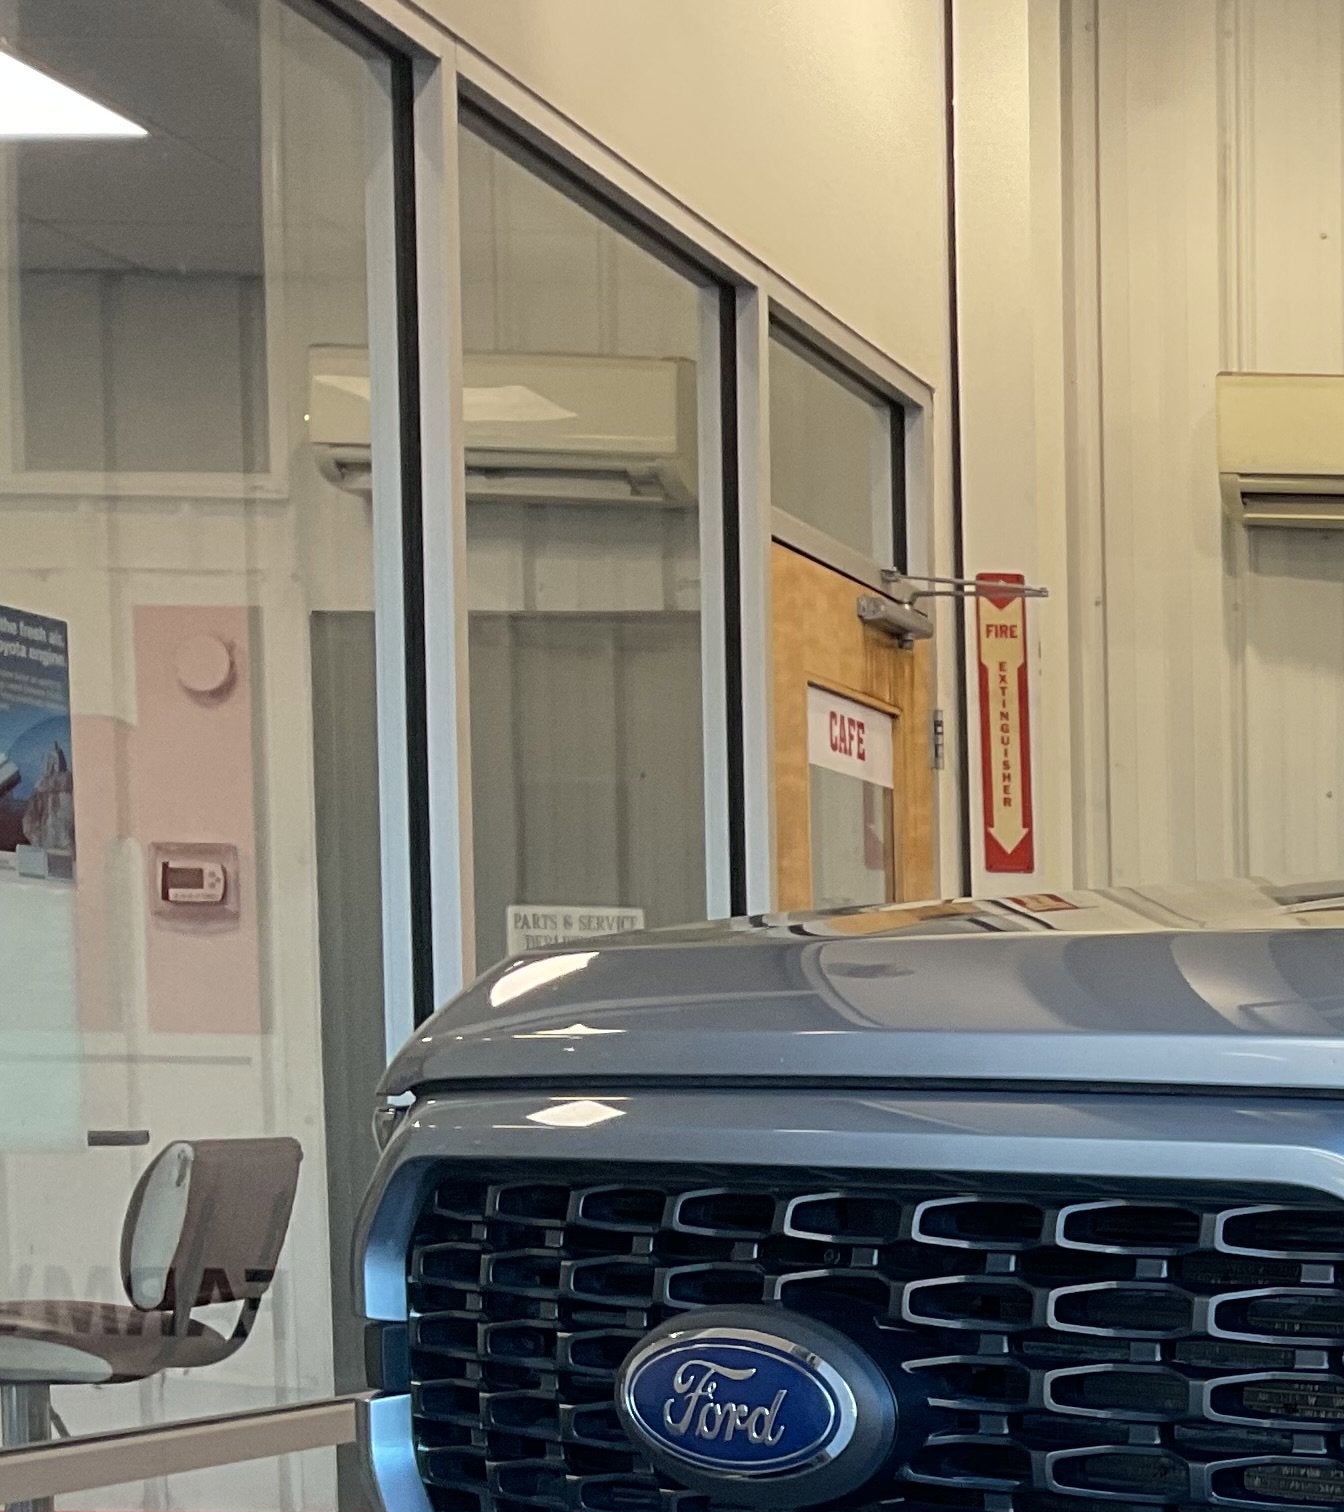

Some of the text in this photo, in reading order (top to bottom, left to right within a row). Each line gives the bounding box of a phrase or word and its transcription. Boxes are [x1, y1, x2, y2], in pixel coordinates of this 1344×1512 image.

[985, 624, 1018, 639] FIRE
[829, 710, 866, 761] CAFE
[998, 661, 1012, 807] EXTINGUISHER
[513, 913, 638, 932] PARTS & SERVICE
[664, 1359, 788, 1446] Ford
